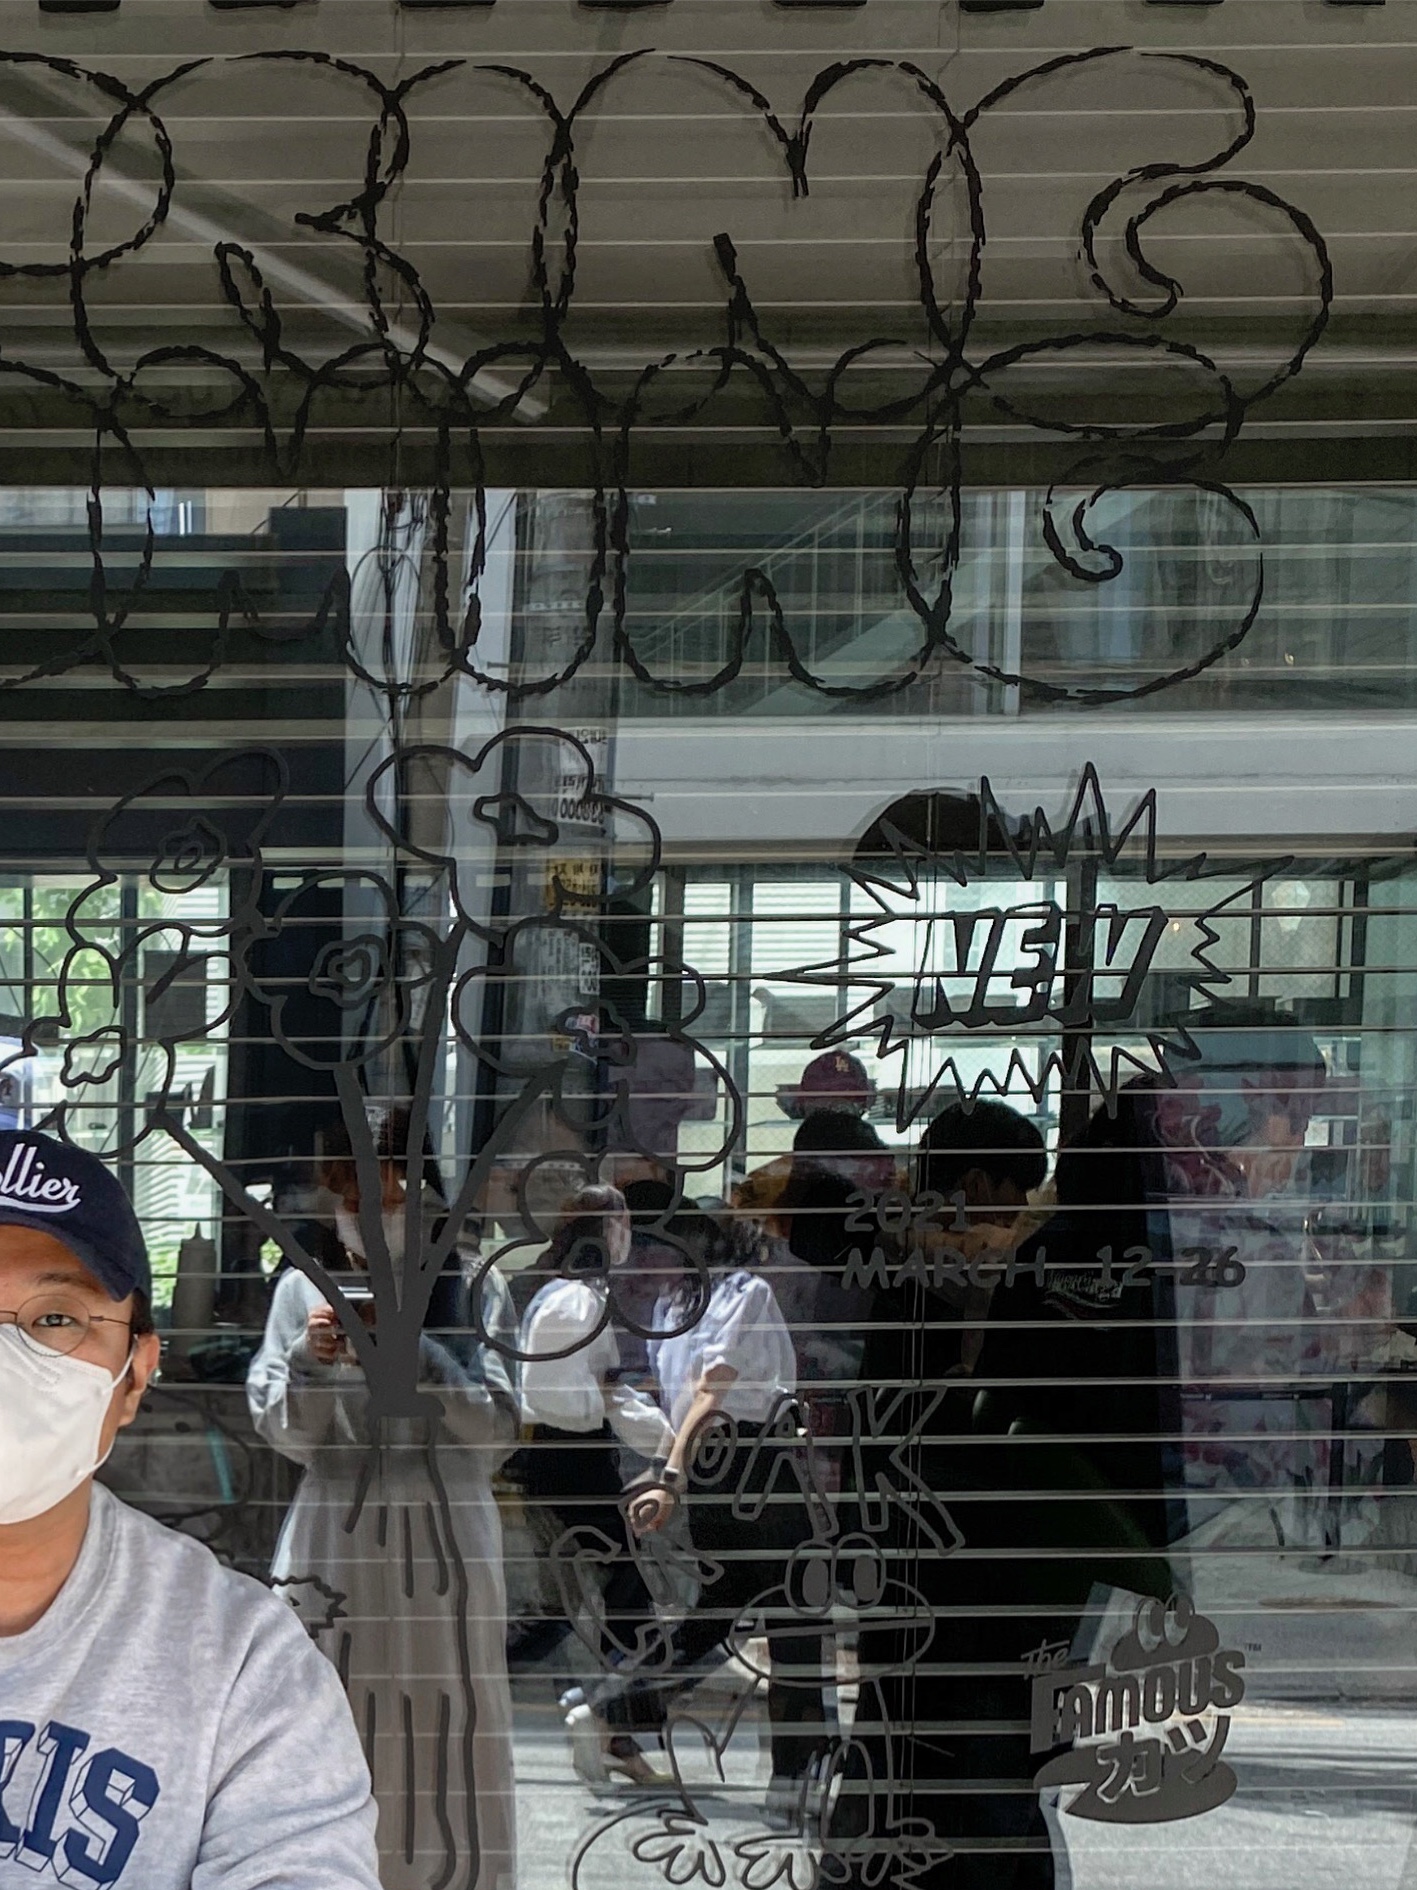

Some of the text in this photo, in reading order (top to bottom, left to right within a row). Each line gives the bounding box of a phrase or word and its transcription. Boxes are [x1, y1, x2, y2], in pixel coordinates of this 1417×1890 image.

[911, 902, 1169, 1030] NEW
[846, 1191, 969, 1232] 2021
[840, 1246, 1047, 1290] MARCH
[1095, 1246, 1247, 1290] 12-26
